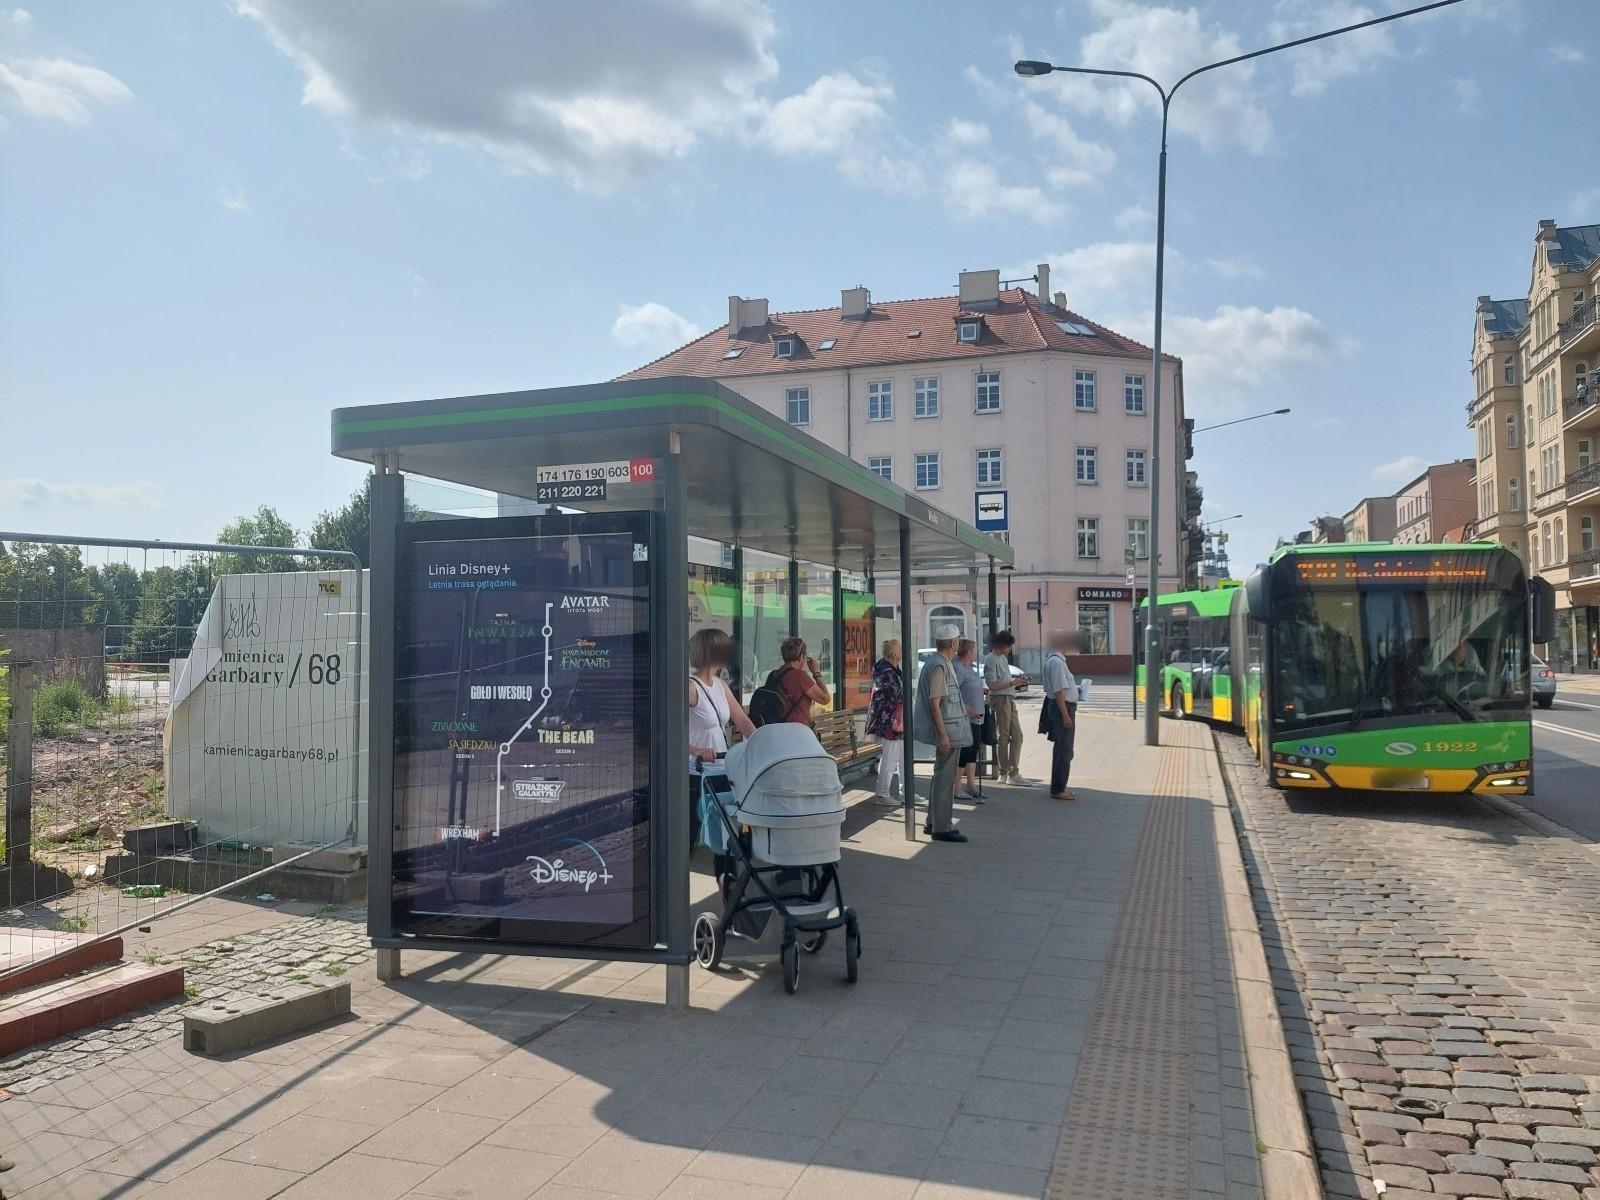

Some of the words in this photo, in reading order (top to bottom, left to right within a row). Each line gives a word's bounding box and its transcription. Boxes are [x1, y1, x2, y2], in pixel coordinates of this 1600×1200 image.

[539, 471, 558, 482] 174
[561, 470, 581, 481] 176
[584, 468, 604, 479] 190
[608, 466, 629, 478] 603
[632, 464, 653, 476] 100
[539, 487, 558, 499] 211
[561, 485, 581, 498] 220
[584, 485, 604, 496] 221
[428, 563, 456, 576] Linia
[460, 562, 511, 576] Disney+
[428, 580, 453, 589] Letnia
[454, 580, 475, 588] trasa
[1080, 590, 1122, 598] LOMBARD
[560, 594, 610, 609] AVATAR
[537, 728, 561, 744] THE
[562, 729, 594, 744] BEAR
[1423, 741, 1478, 752] 1922
[441, 827, 480, 841] WREXHAM
